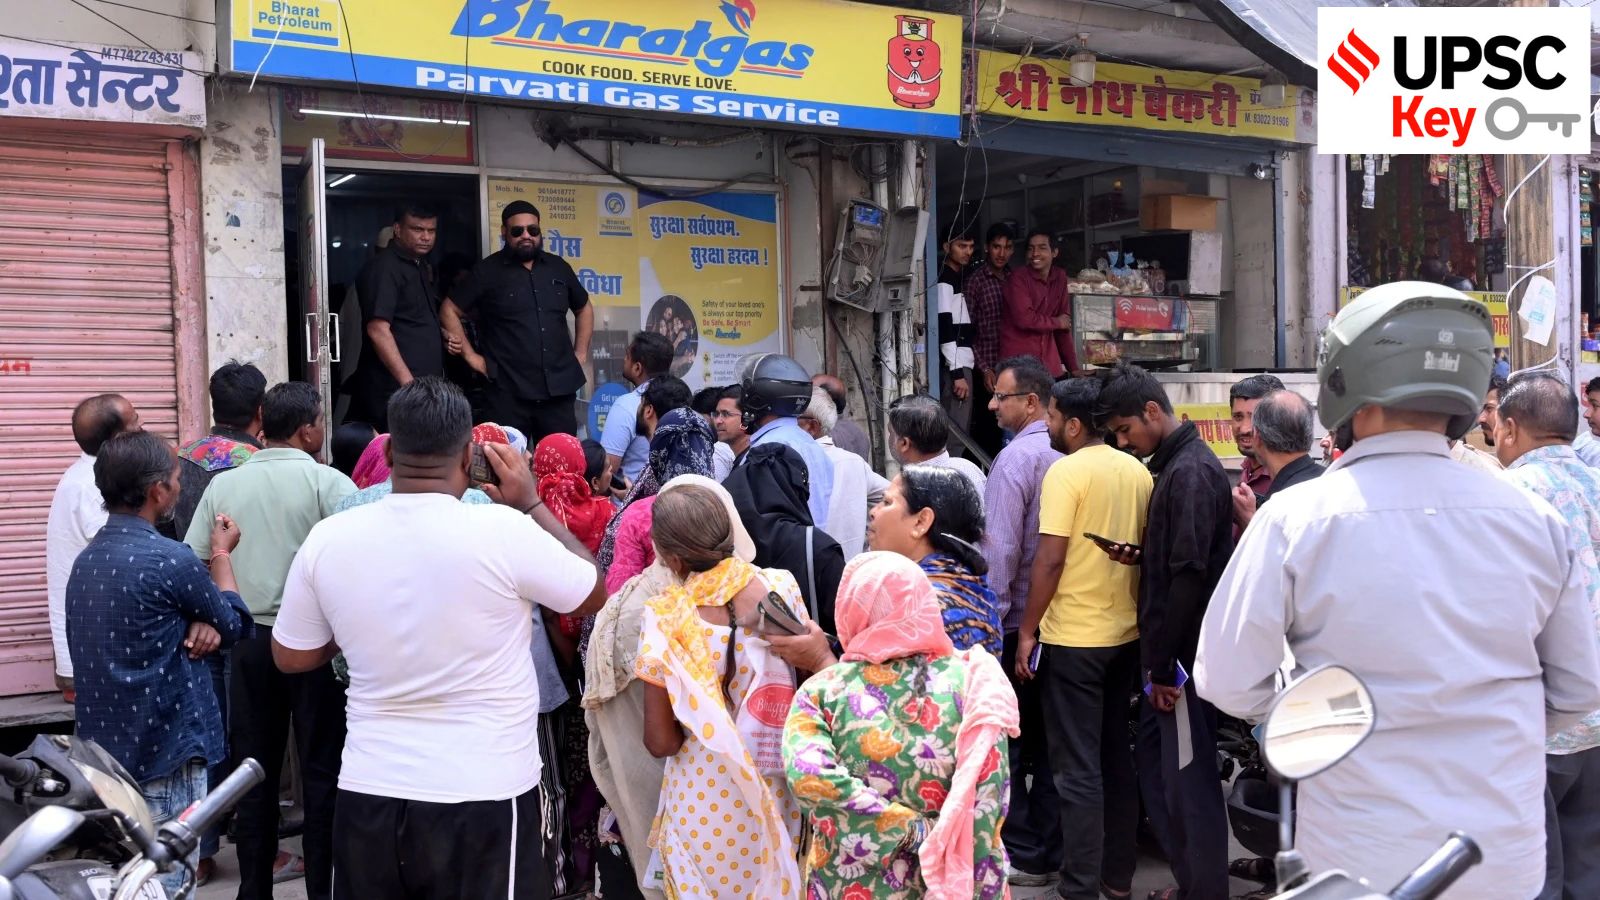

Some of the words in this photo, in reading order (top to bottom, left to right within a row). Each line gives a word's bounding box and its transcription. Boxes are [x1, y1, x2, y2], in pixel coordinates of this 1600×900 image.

[258, 12, 332, 32] Petroleum
[272, 1, 320, 18] Bharat
[450, 0, 815, 77] Bharatgas
[66, 50, 183, 113] सेन्टर
[542, 60, 585, 77] COOK
[591, 65, 638, 82] FOOD.
[642, 71, 691, 87] SERVE
[695, 76, 737, 91] LOVE.
[416, 66, 590, 102] Parvati
[604, 87, 681, 110] Gas
[692, 95, 840, 126] Service
[995, 63, 1052, 110] श्री
[1058, 77, 1138, 117] नाथ
[1142, 76, 1241, 128] बेकरी
[649, 215, 685, 239] सुरक्षा
[547, 229, 582, 257] गैस
[690, 246, 725, 270] सुरक्षा
[727, 248, 760, 266] हरदम
[577, 268, 623, 295] विधा
[719, 300, 725, 308] of
